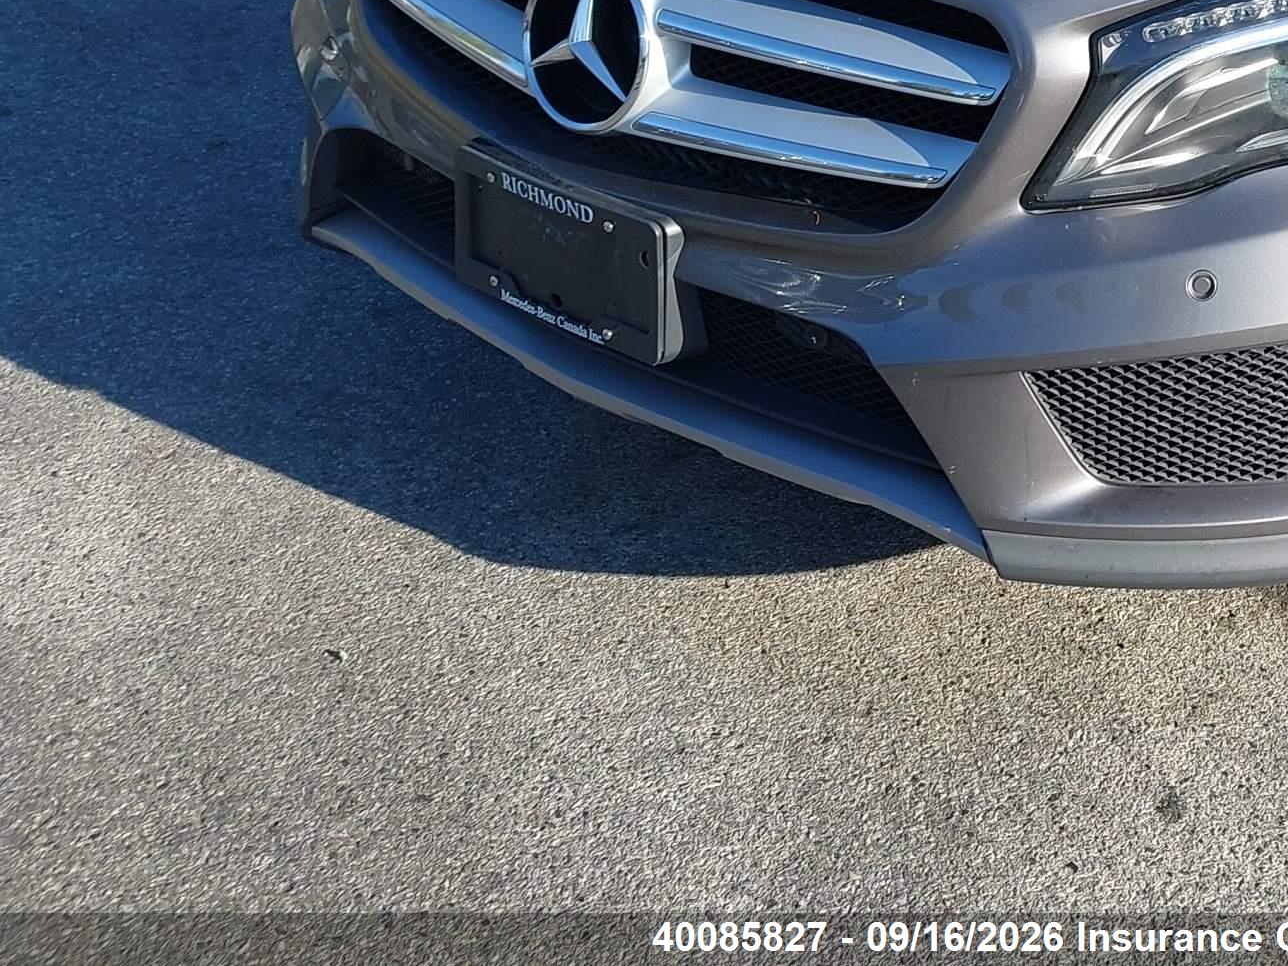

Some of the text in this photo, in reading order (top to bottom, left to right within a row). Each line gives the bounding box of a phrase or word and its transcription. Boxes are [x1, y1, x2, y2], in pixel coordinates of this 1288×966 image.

[500, 172, 594, 224] RICHMOND
[500, 288, 556, 325] Mercedes-Benz
[556, 315, 588, 338] Canada
